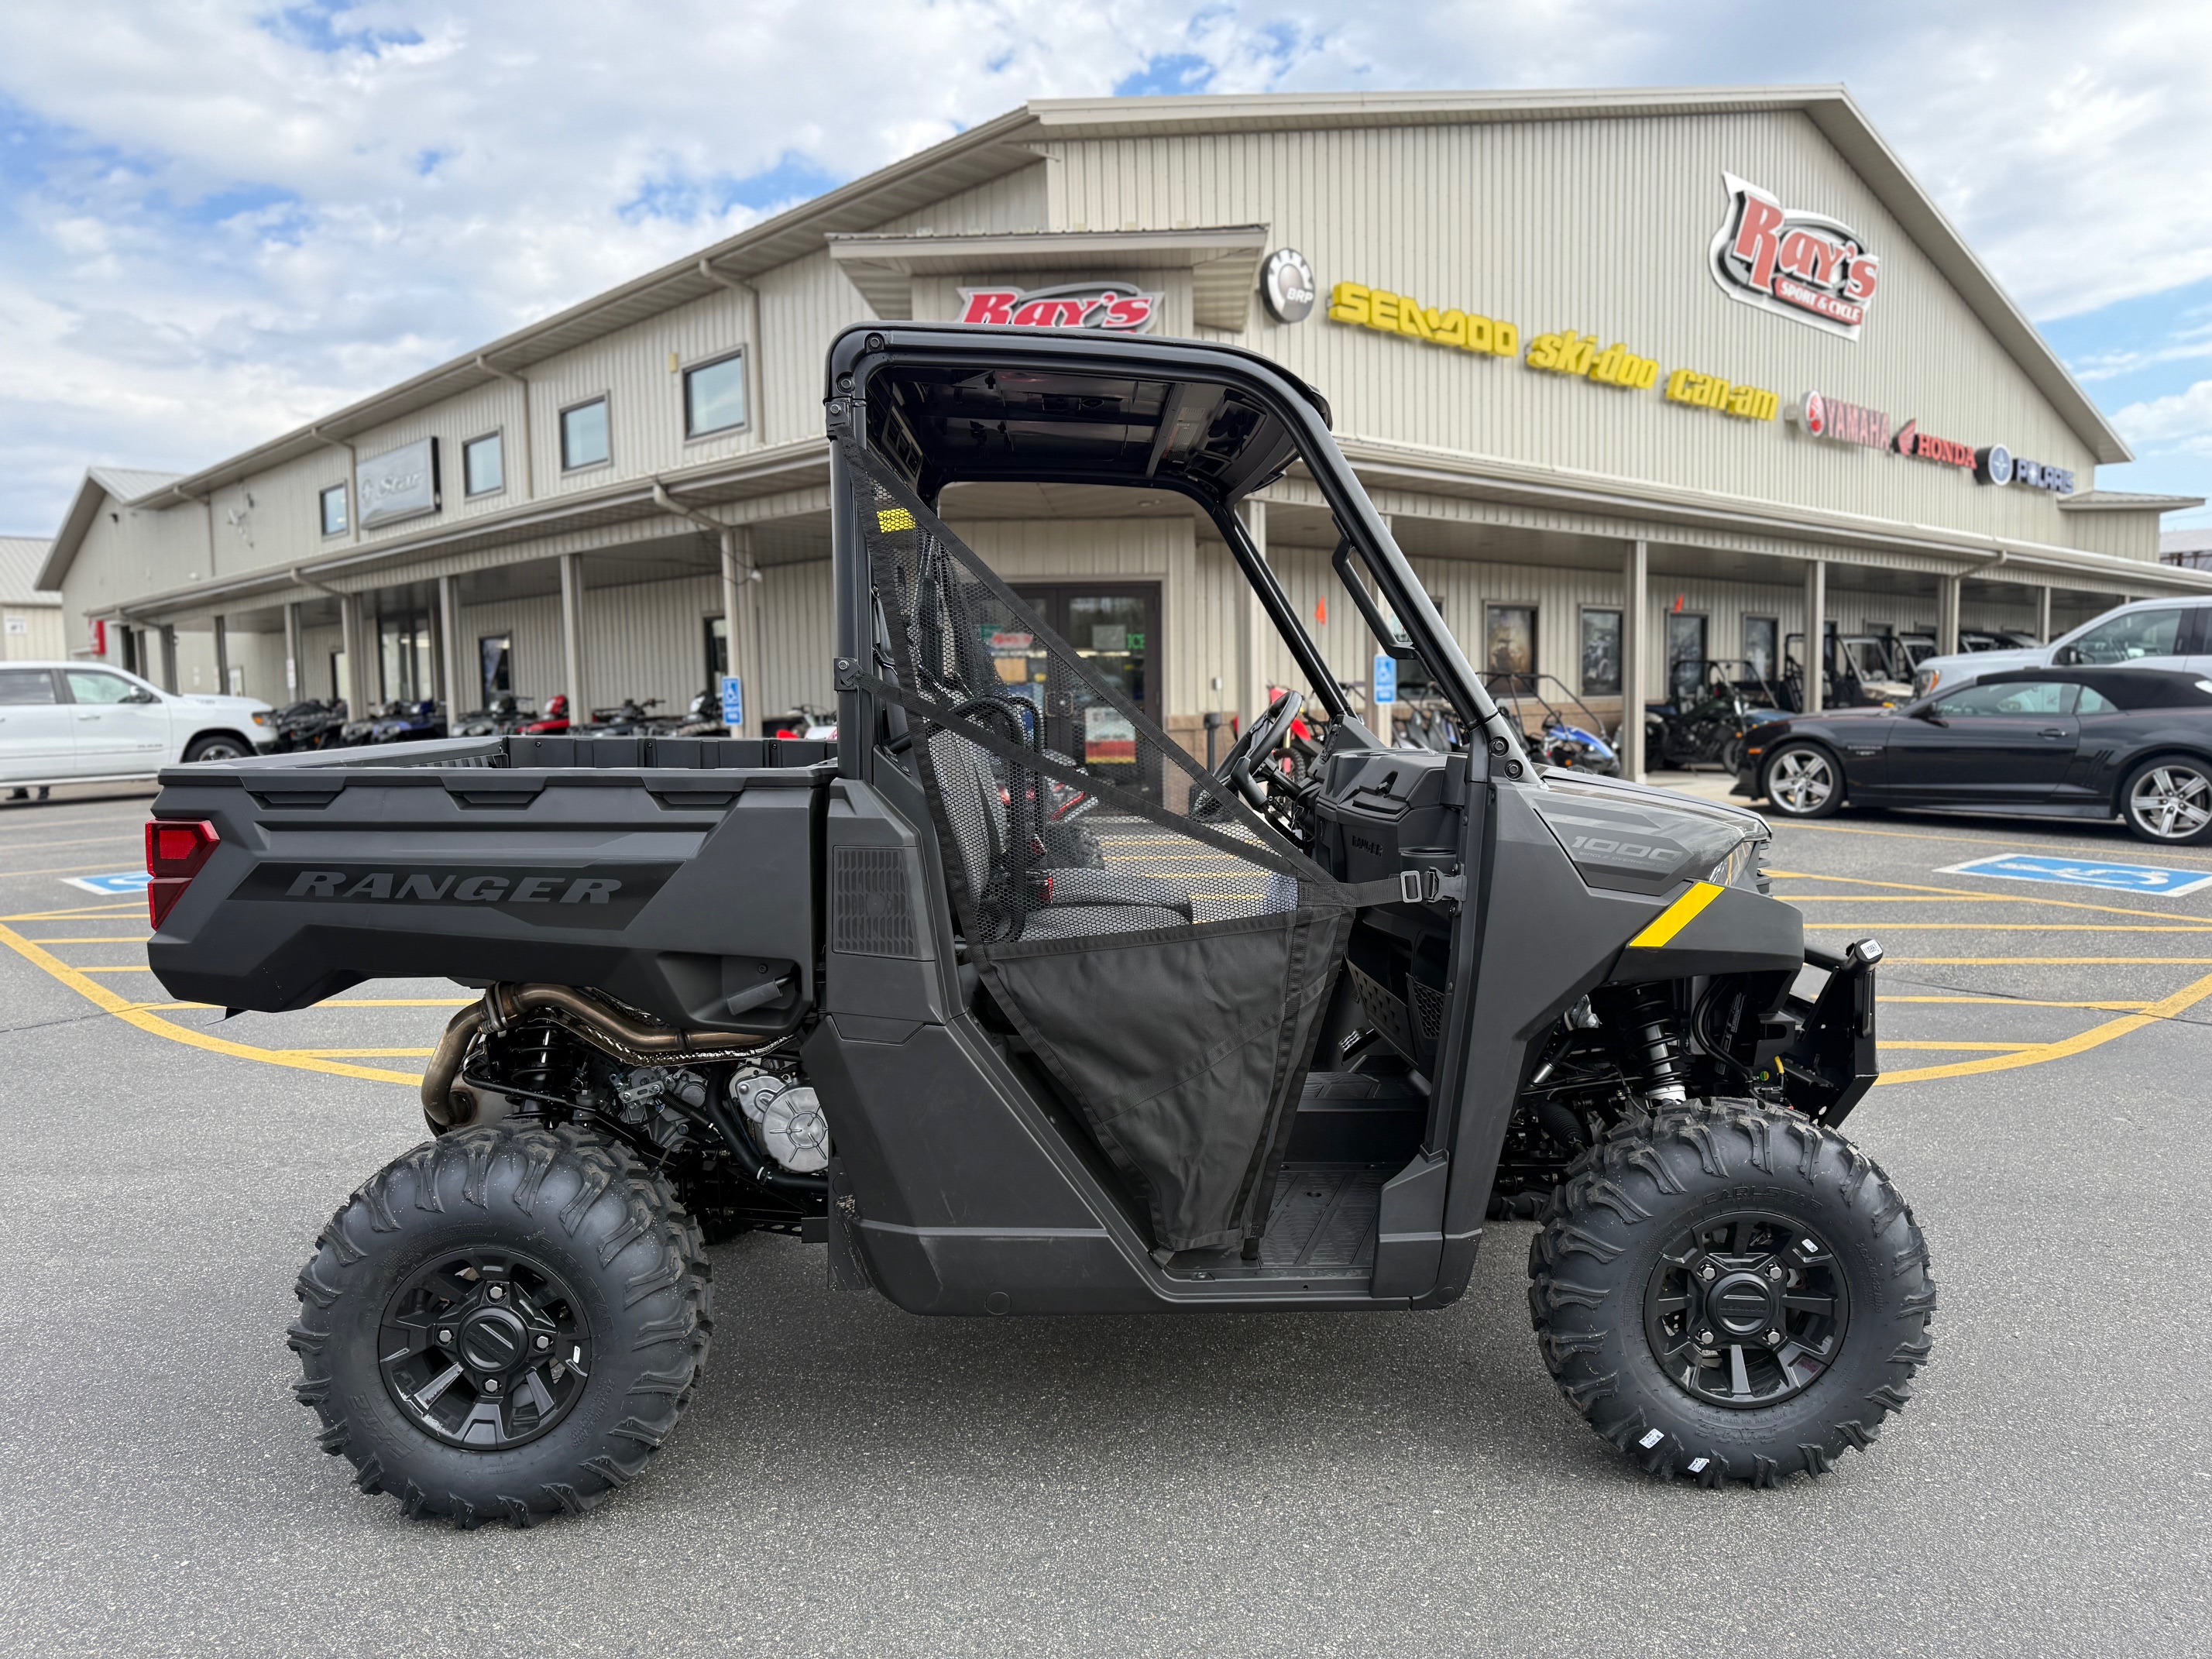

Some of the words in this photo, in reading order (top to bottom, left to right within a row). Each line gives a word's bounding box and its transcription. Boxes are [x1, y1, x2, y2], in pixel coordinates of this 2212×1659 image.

[1286, 287, 1314, 304] BRP
[1780, 280, 1816, 304] SPORT
[1817, 296, 1828, 310] &
[1828, 299, 1861, 322] CYCLE
[1825, 397, 1891, 451] YAMAHA
[1917, 434, 1977, 469] HONDA
[2014, 458, 2075, 493] POLARIS
[1127, 634, 1145, 649] ICE
[1571, 836, 1683, 863] 1000
[284, 870, 622, 905] RANGER
